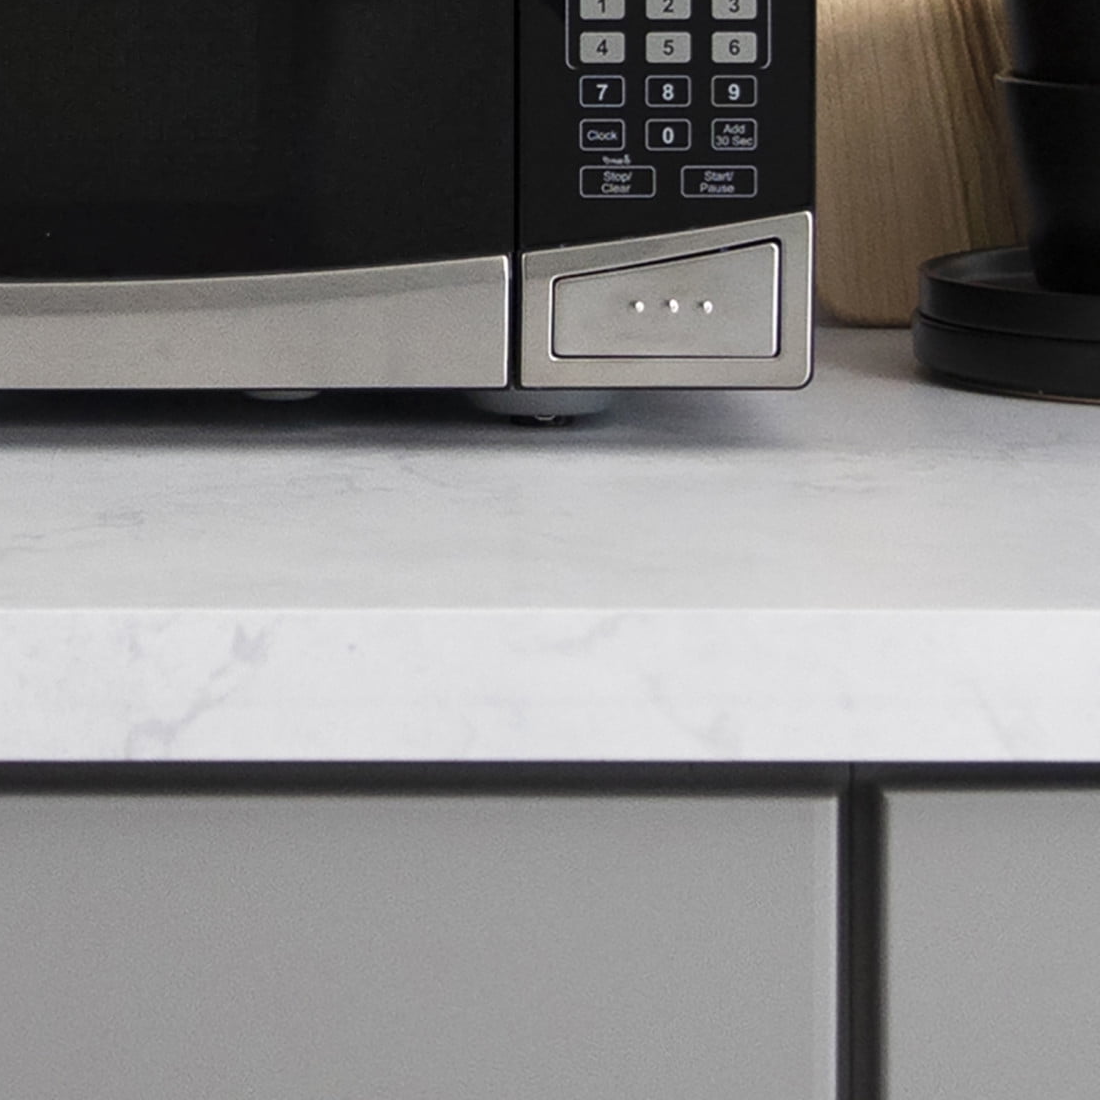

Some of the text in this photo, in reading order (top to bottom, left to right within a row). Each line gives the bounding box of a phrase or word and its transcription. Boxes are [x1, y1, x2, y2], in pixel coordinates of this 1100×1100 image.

[596, 39, 609, 56] 4
[663, 39, 674, 56] 5
[728, 39, 740, 56] 6
[596, 83, 609, 101] 7
[662, 83, 674, 101] 8
[728, 83, 740, 101] 9
[586, 130, 618, 141] Clock
[662, 127, 674, 144] 0
[723, 124, 746, 134] Add
[715, 136, 753, 146] 30 Sec
[603, 171, 633, 183] Stop/
[704, 171, 734, 181] Start/
[601, 183, 631, 194] Clear
[700, 183, 736, 194] Pause
